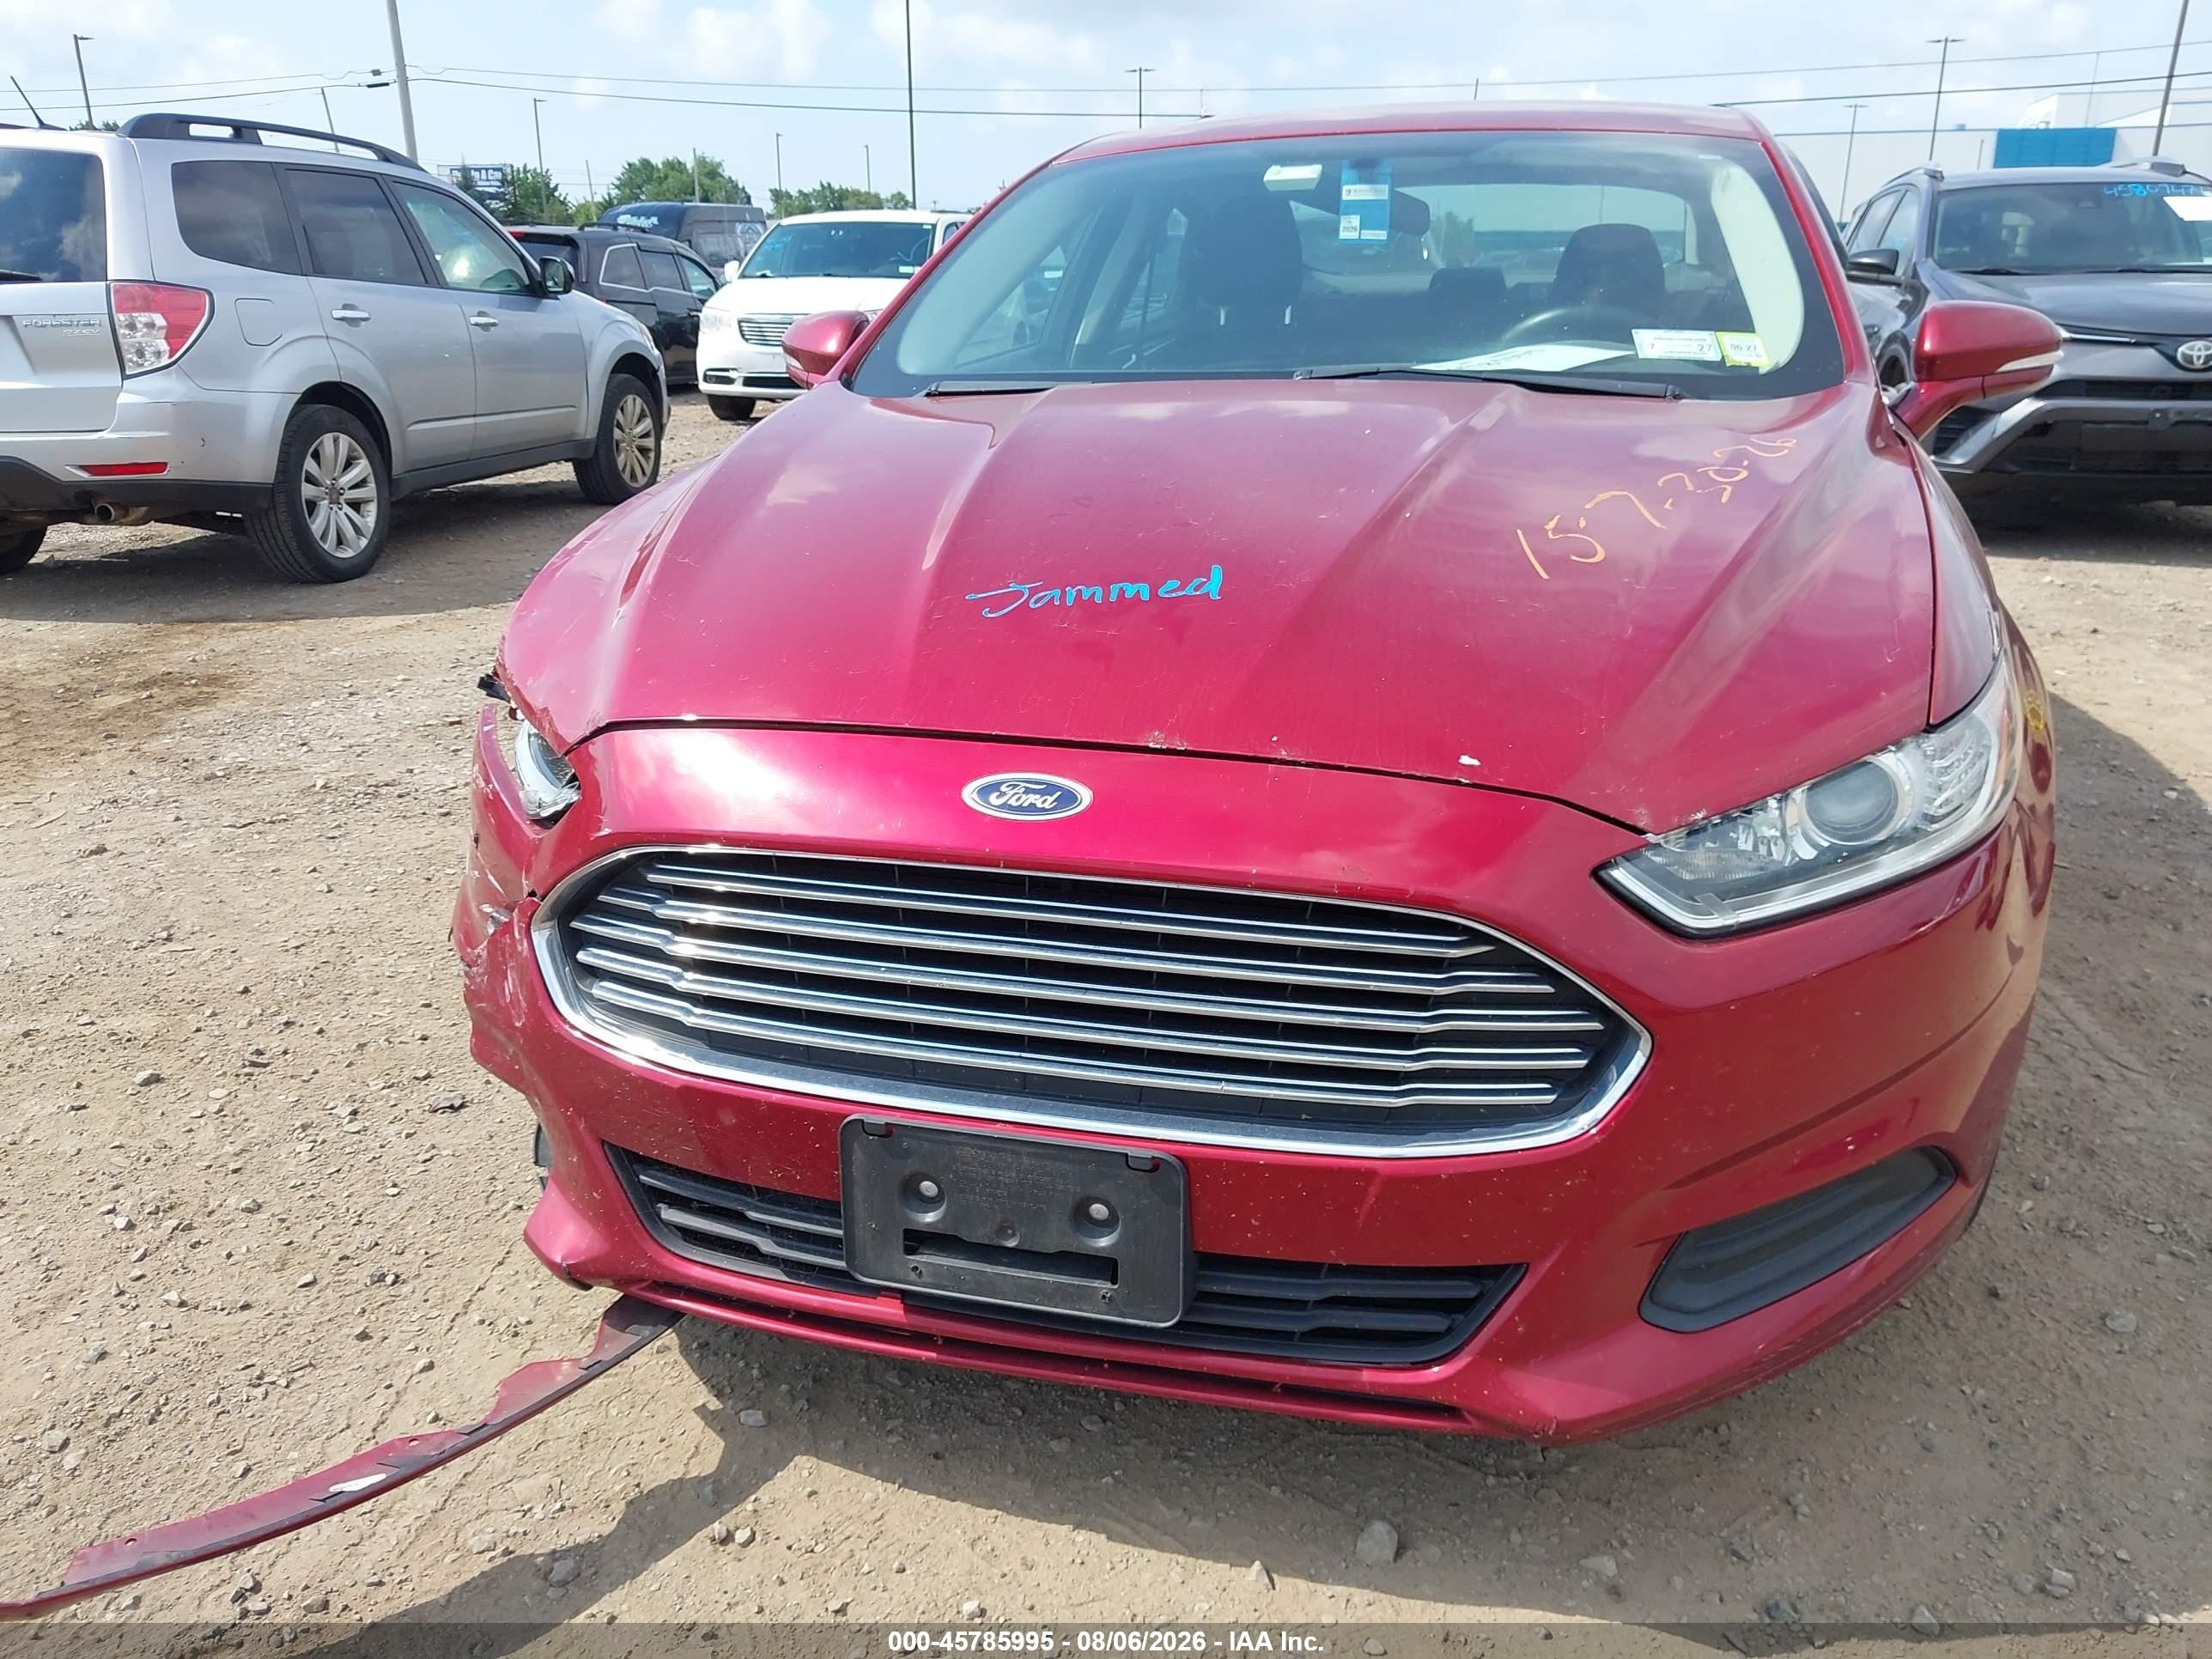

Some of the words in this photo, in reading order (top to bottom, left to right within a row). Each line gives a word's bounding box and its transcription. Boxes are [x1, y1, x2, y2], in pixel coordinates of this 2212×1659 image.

[22, 318, 102, 328] FORESTER
[1698, 343, 1712, 352] 27
[965, 564, 1223, 618] Jammed
[988, 781, 1063, 810] Ford
